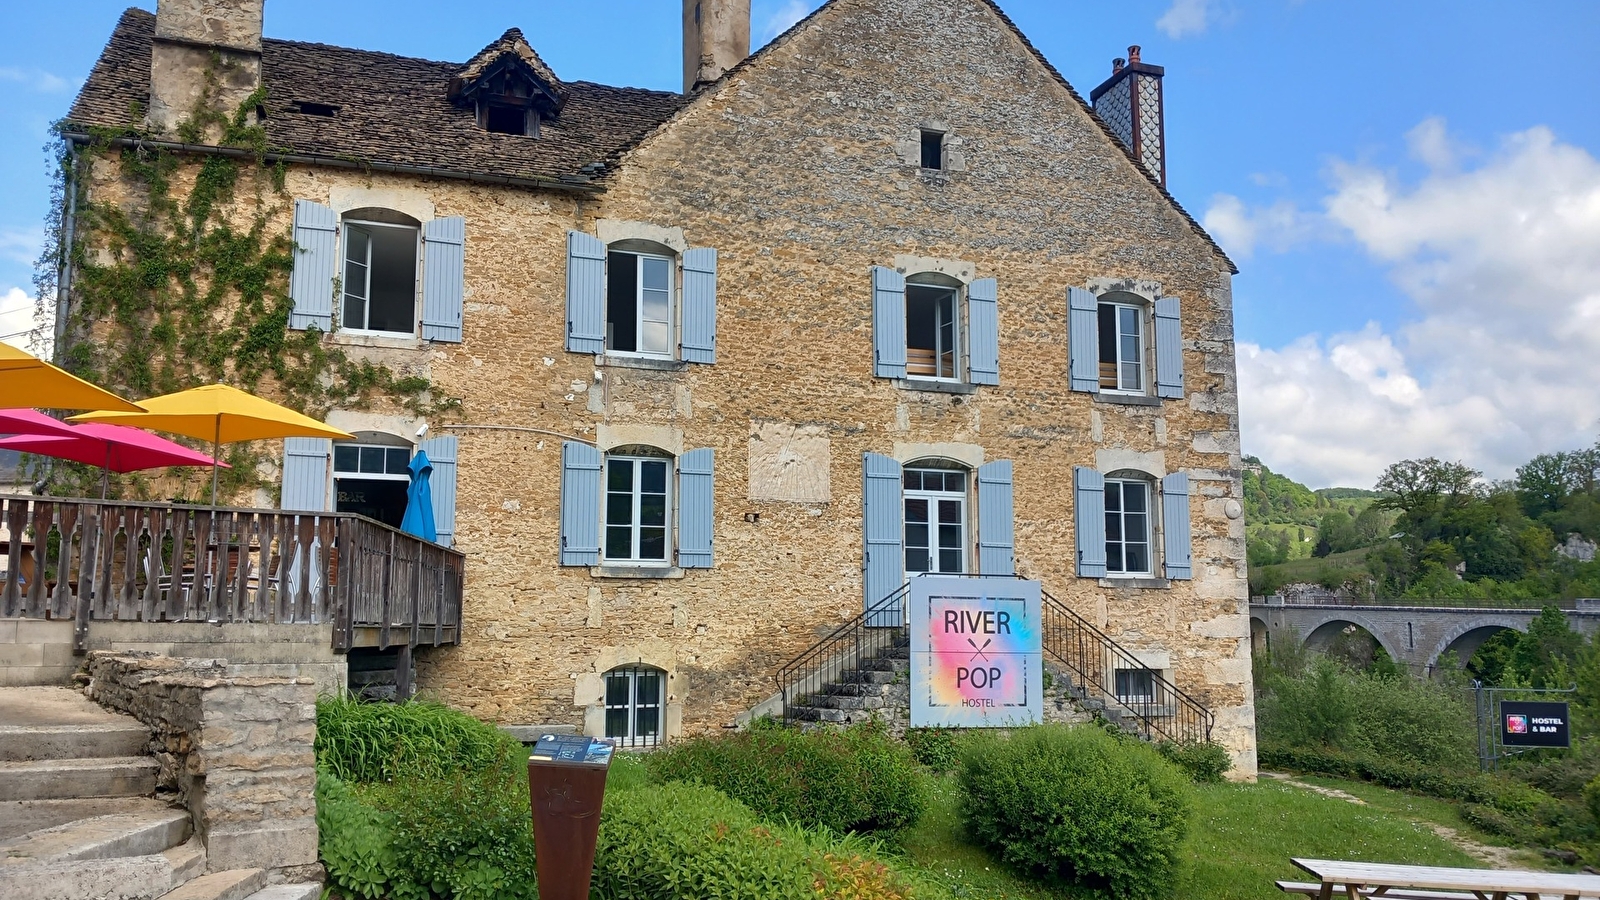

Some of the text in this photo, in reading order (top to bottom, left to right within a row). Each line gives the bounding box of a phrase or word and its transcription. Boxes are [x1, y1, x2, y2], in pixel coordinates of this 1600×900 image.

[337, 491, 366, 503] BAR
[944, 610, 1011, 634] RIVER
[957, 667, 1001, 689] POP
[961, 698, 996, 708] HOSTEL
[1531, 717, 1564, 725] HOSTEL
